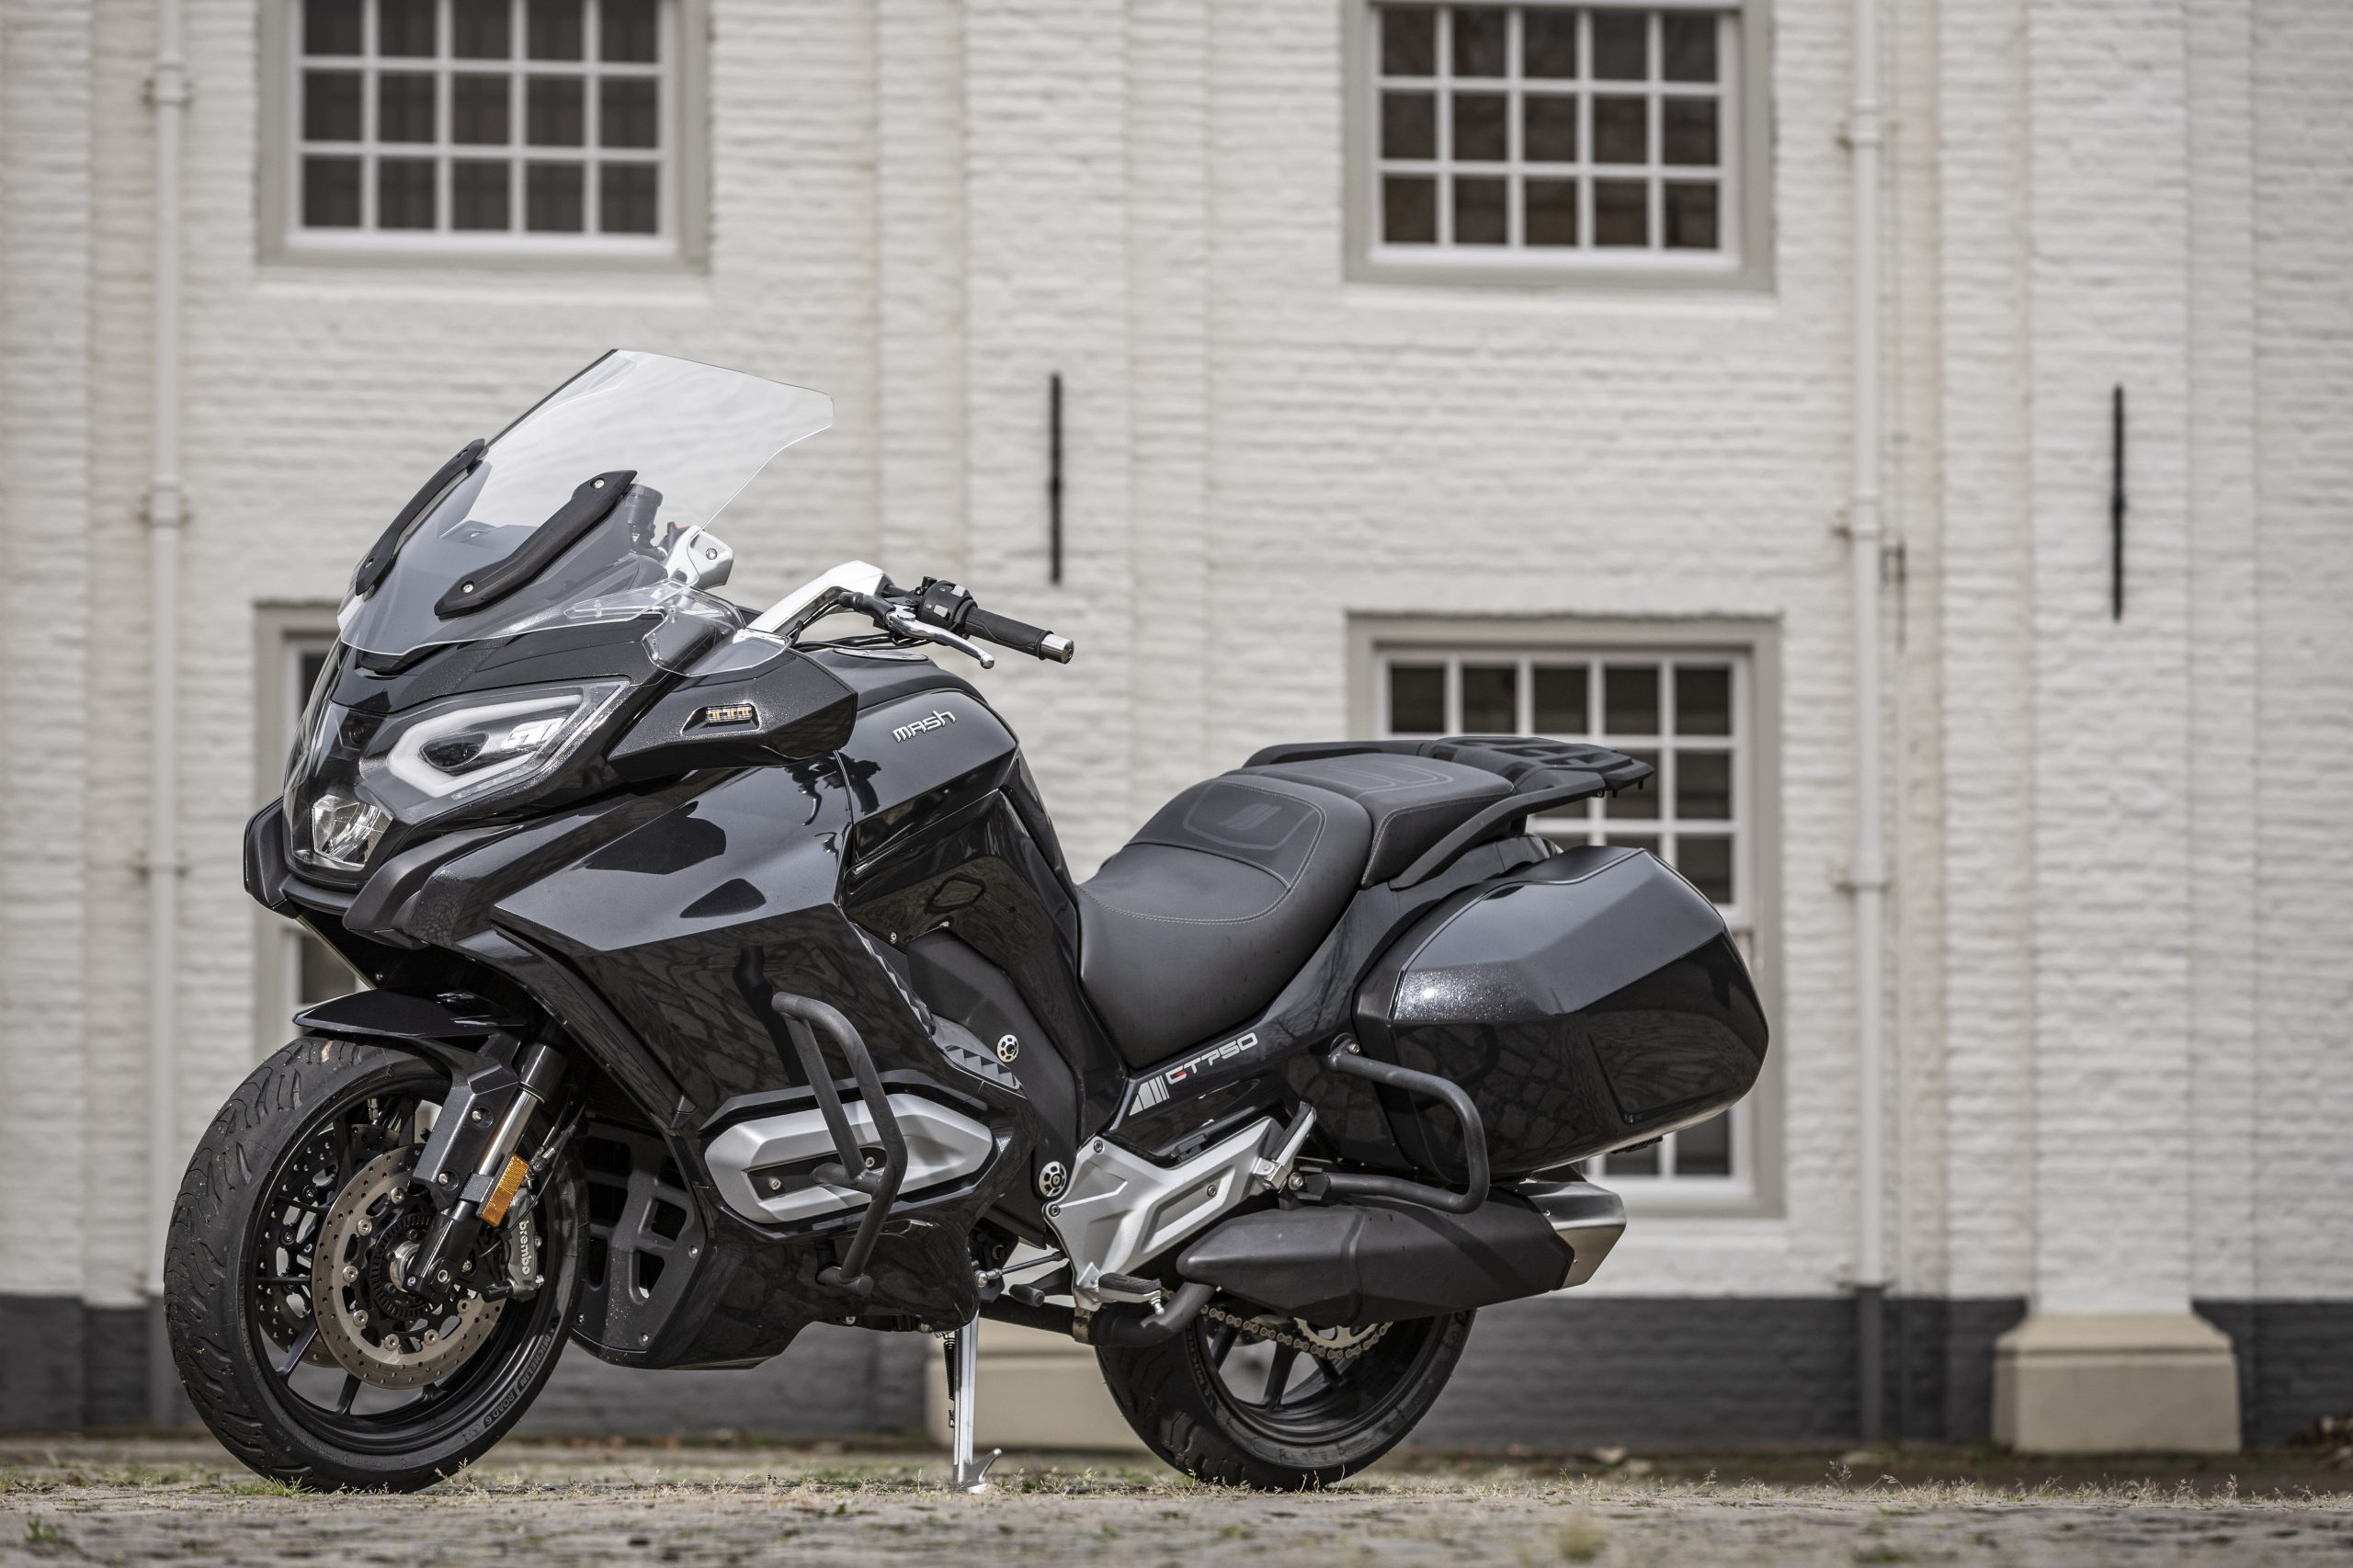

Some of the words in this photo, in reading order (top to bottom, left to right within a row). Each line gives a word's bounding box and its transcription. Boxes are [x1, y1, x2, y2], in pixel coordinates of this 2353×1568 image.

[1165, 1032, 1258, 1085] GT750
[518, 1220, 532, 1275] brembo
[520, 1335, 551, 1387] MICHELIN
[484, 1415, 493, 1425] 6
[492, 1391, 516, 1415] ROAD
